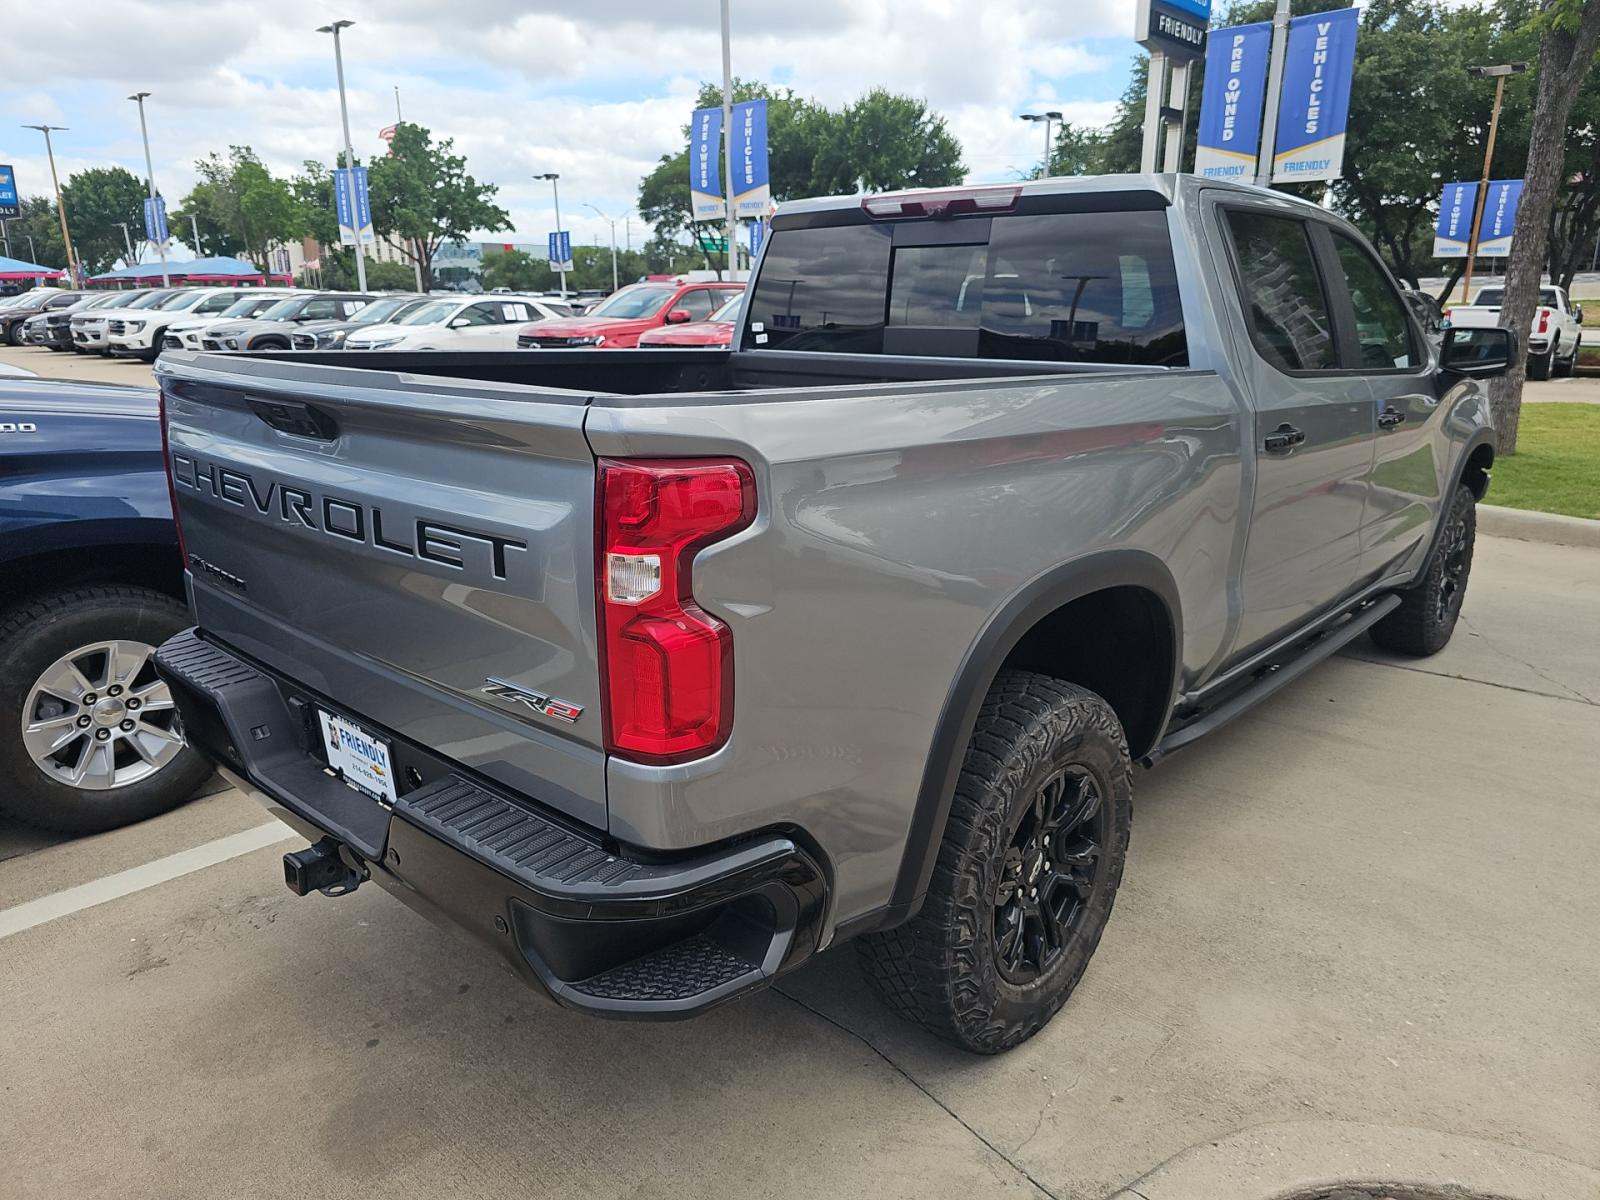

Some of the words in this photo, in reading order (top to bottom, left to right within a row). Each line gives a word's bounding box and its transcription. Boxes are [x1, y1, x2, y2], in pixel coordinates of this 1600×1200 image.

[1158, 15, 1203, 45] FRIENDLY
[1230, 35, 1245, 73] PRE
[1305, 22, 1331, 134] VEHICLES
[1222, 78, 1241, 142] OWNED
[744, 108, 754, 185] VEHICLES
[1284, 160, 1330, 172] FRIENDLY
[1203, 165, 1245, 177] FRIENDLY
[173, 455, 528, 581] CHEVROLET
[480, 677, 585, 723] ZR2
[339, 727, 387, 768] FRIENDLY
